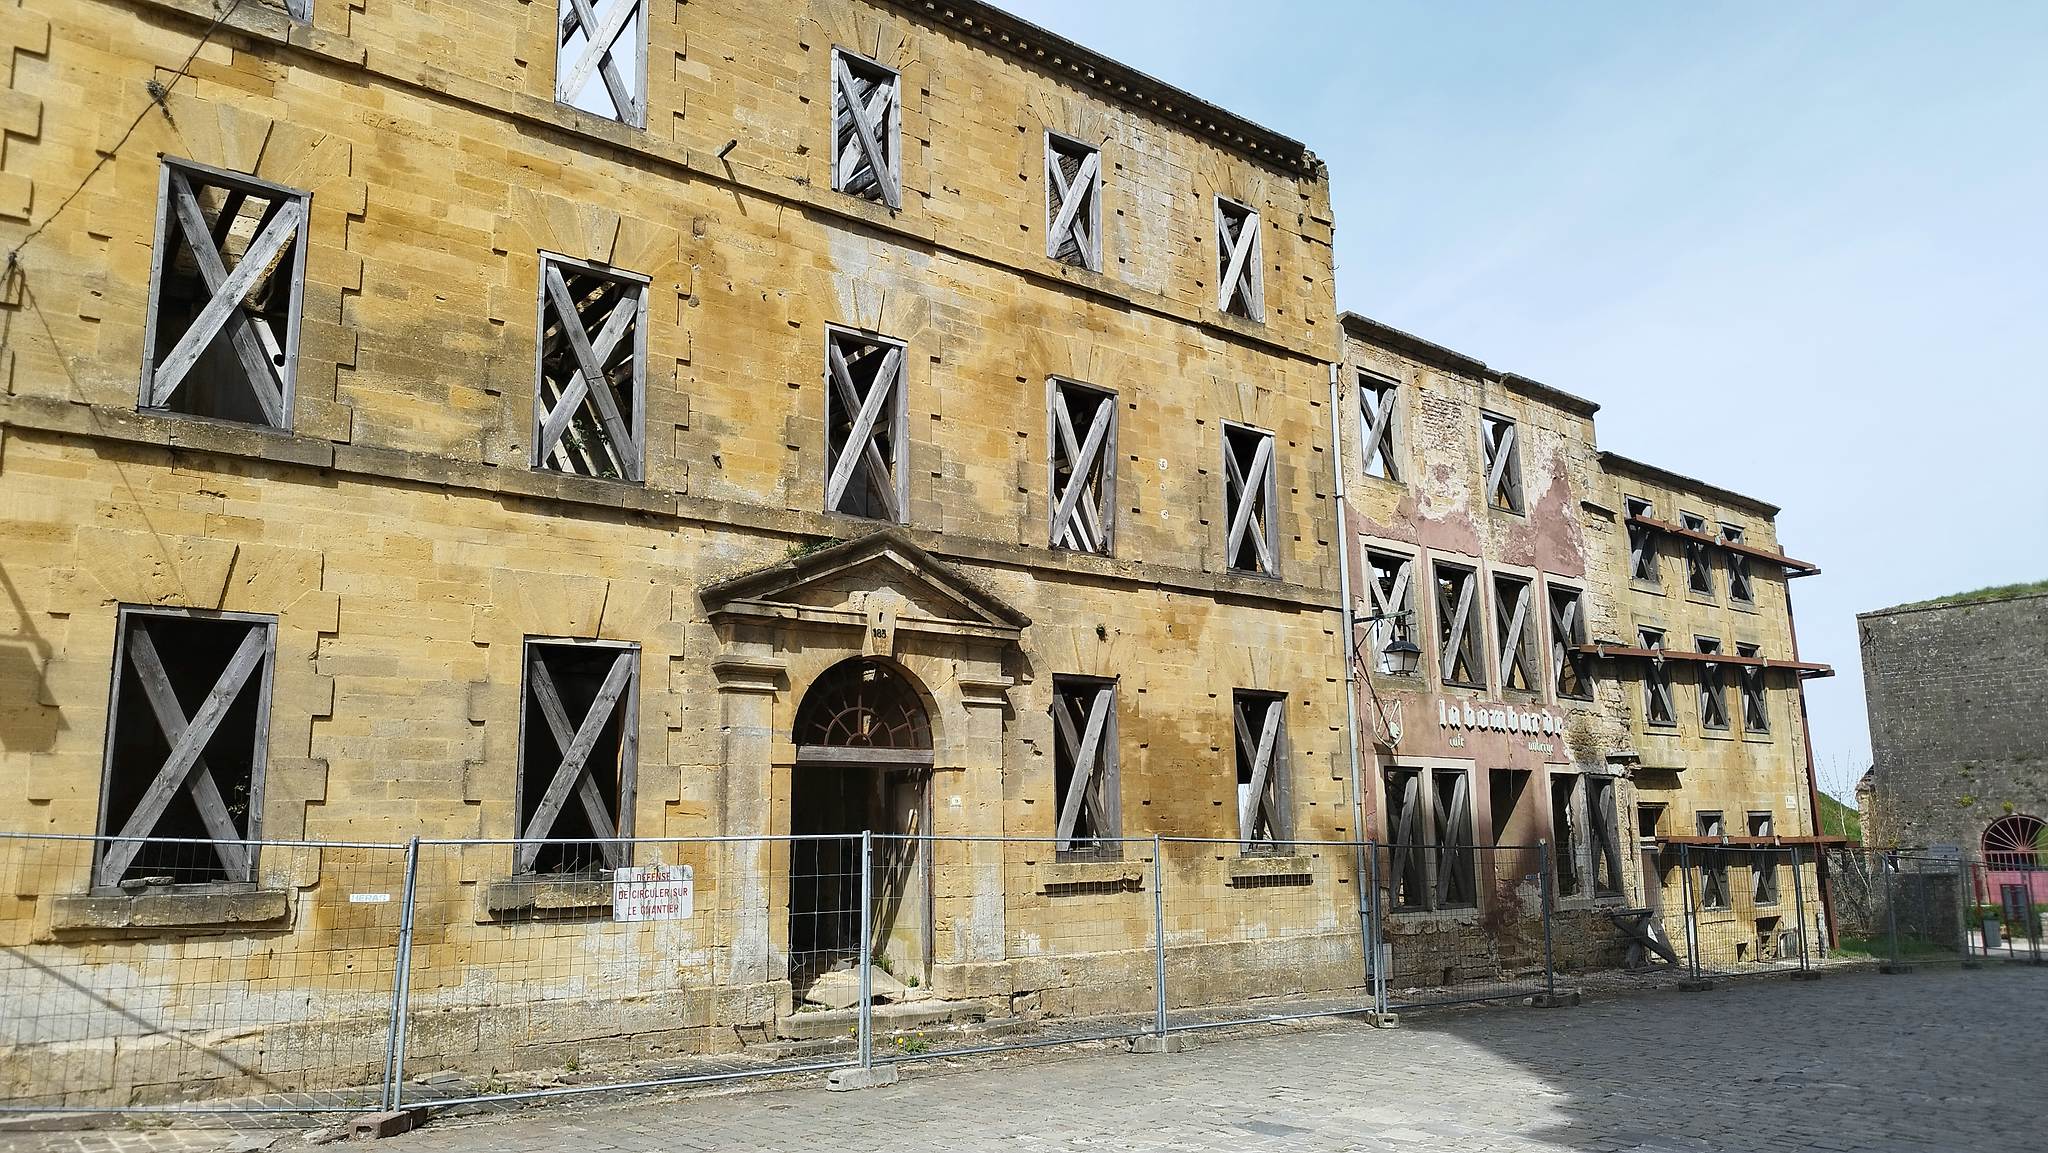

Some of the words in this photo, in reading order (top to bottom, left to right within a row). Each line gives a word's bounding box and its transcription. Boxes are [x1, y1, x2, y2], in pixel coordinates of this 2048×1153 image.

[618, 890, 628, 900] DE
[632, 888, 669, 899] CIRCULER
[673, 887, 688, 897] SUR
[628, 906, 637, 916] LE
